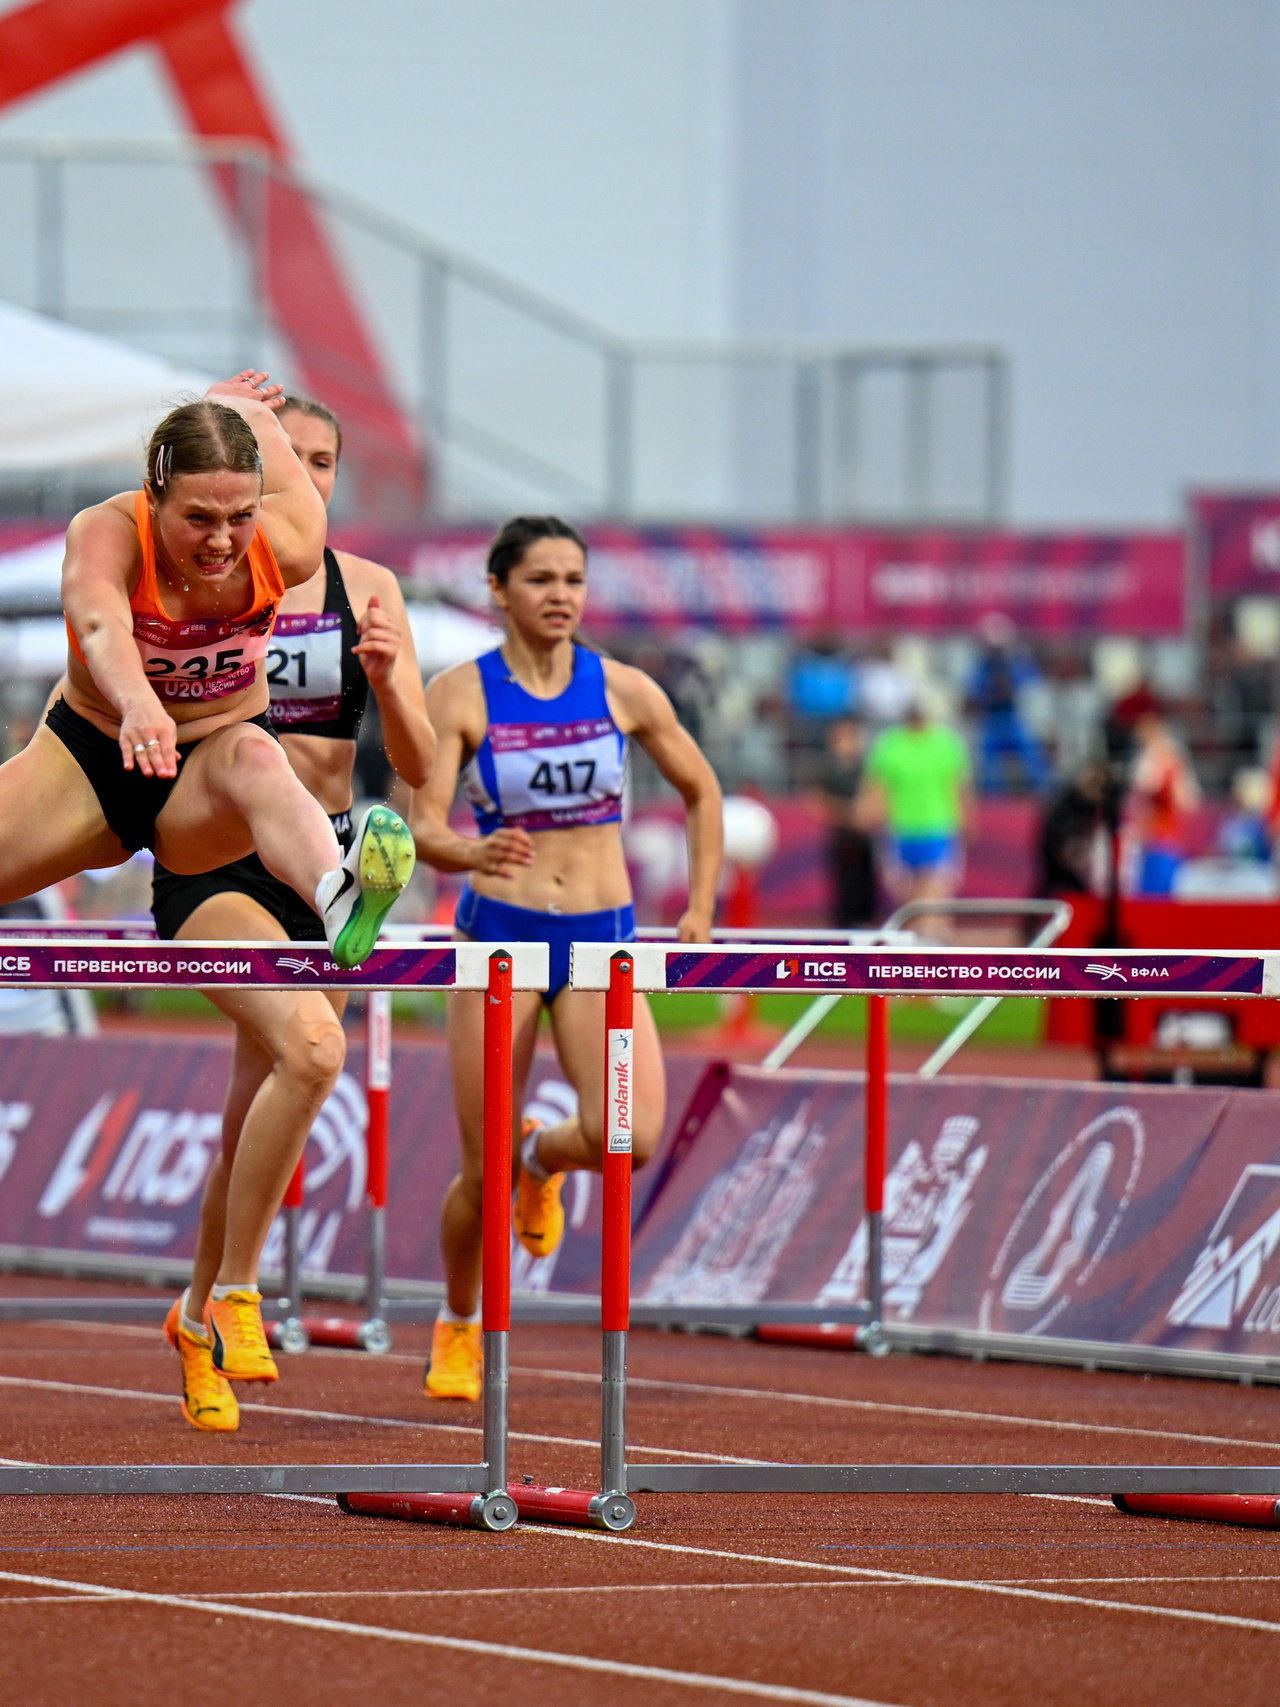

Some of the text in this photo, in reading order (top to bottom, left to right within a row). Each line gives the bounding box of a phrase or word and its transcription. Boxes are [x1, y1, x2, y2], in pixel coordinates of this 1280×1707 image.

[134, 627, 169, 645] FONBET
[144, 648, 245, 681] 235
[164, 681, 205, 698] U20
[528, 759, 597, 795] 417
[54, 960, 251, 974] ПЕРВЕНСТВО РОССИИ
[323, 961, 362, 971] ВФА
[804, 962, 847, 976] ПСБ
[868, 966, 1061, 979] ПЕРВЕНСТВО РОССИИ
[1131, 967, 1170, 977] ВФЛА
[614, 1061, 631, 1130] polanik
